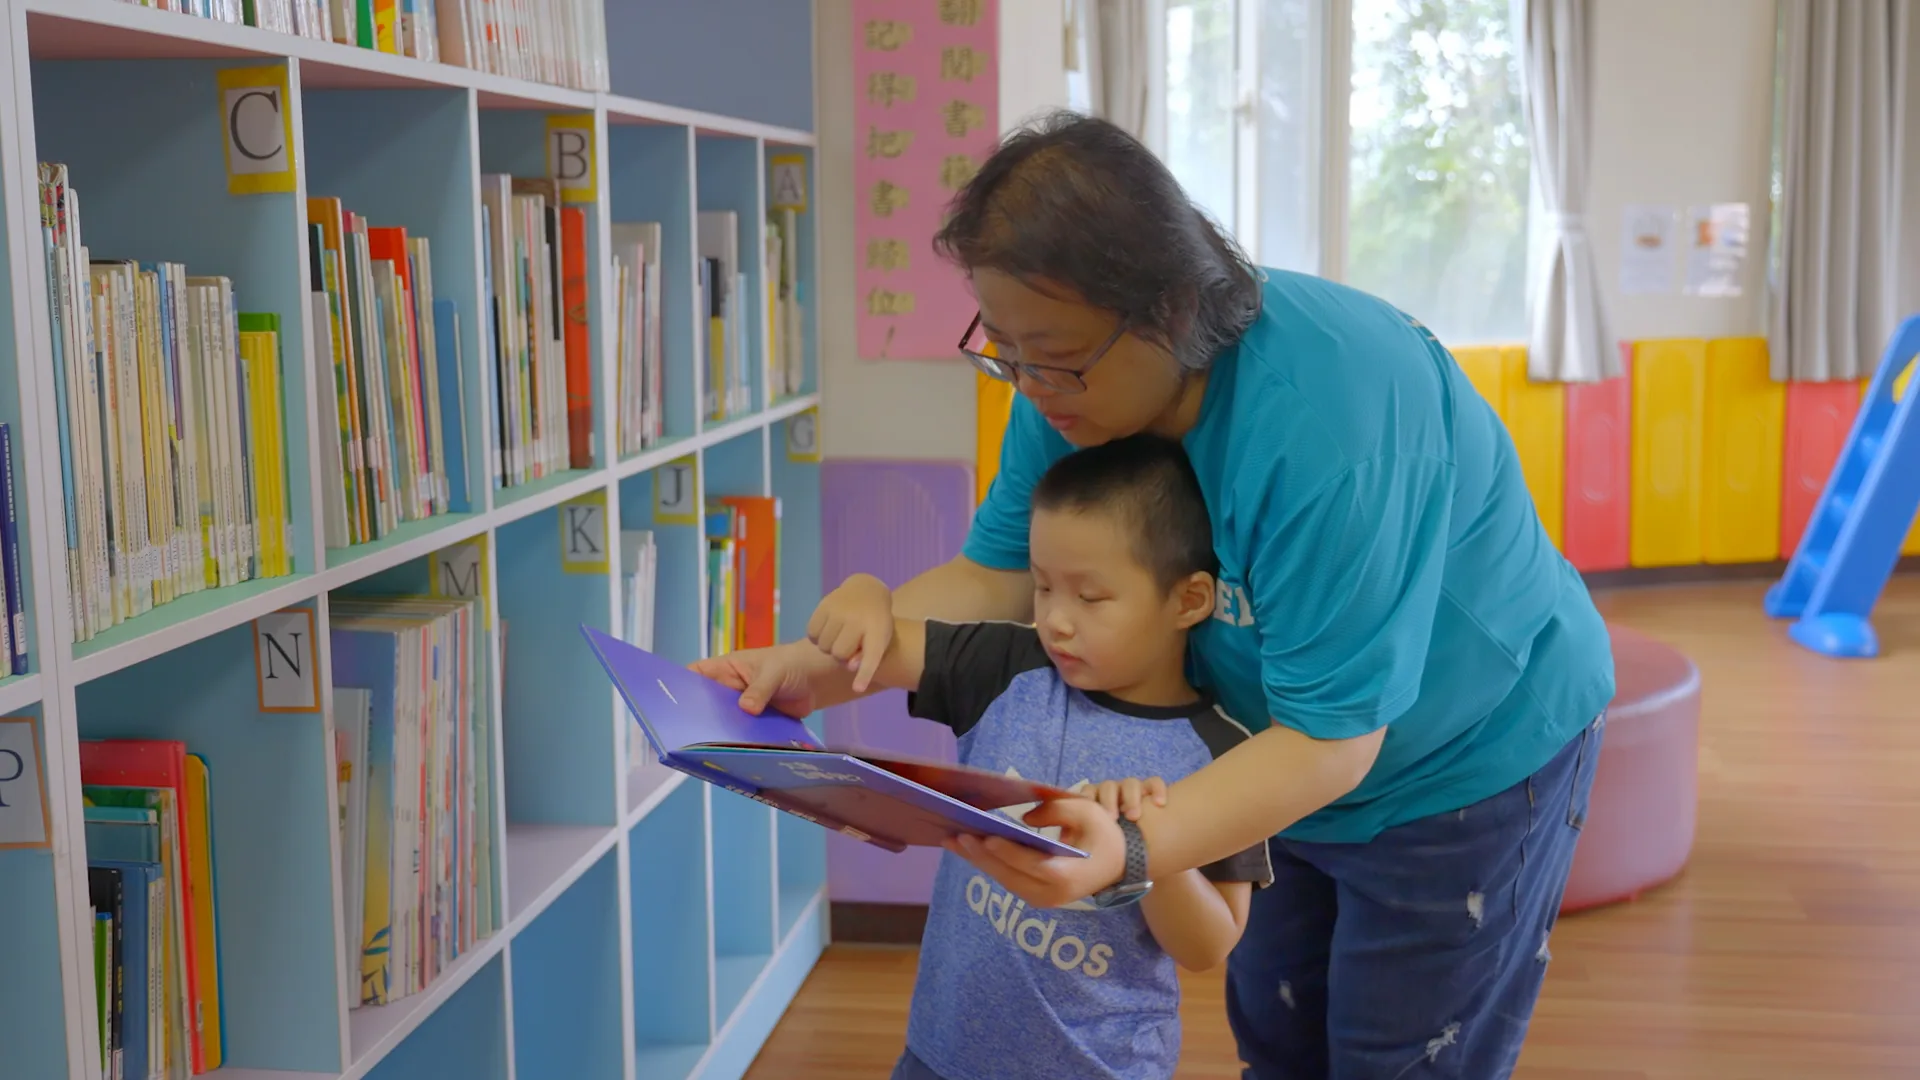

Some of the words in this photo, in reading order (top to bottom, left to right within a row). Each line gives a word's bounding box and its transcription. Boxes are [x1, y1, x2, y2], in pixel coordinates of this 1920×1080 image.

[230, 91, 283, 161] C
[556, 132, 588, 180] B
[777, 168, 800, 202] A
[790, 412, 813, 449] G
[662, 468, 687, 507] J
[568, 507, 600, 554] K
[441, 561, 480, 597] M
[262, 632, 301, 679] N
[0, 748, 24, 808] P
